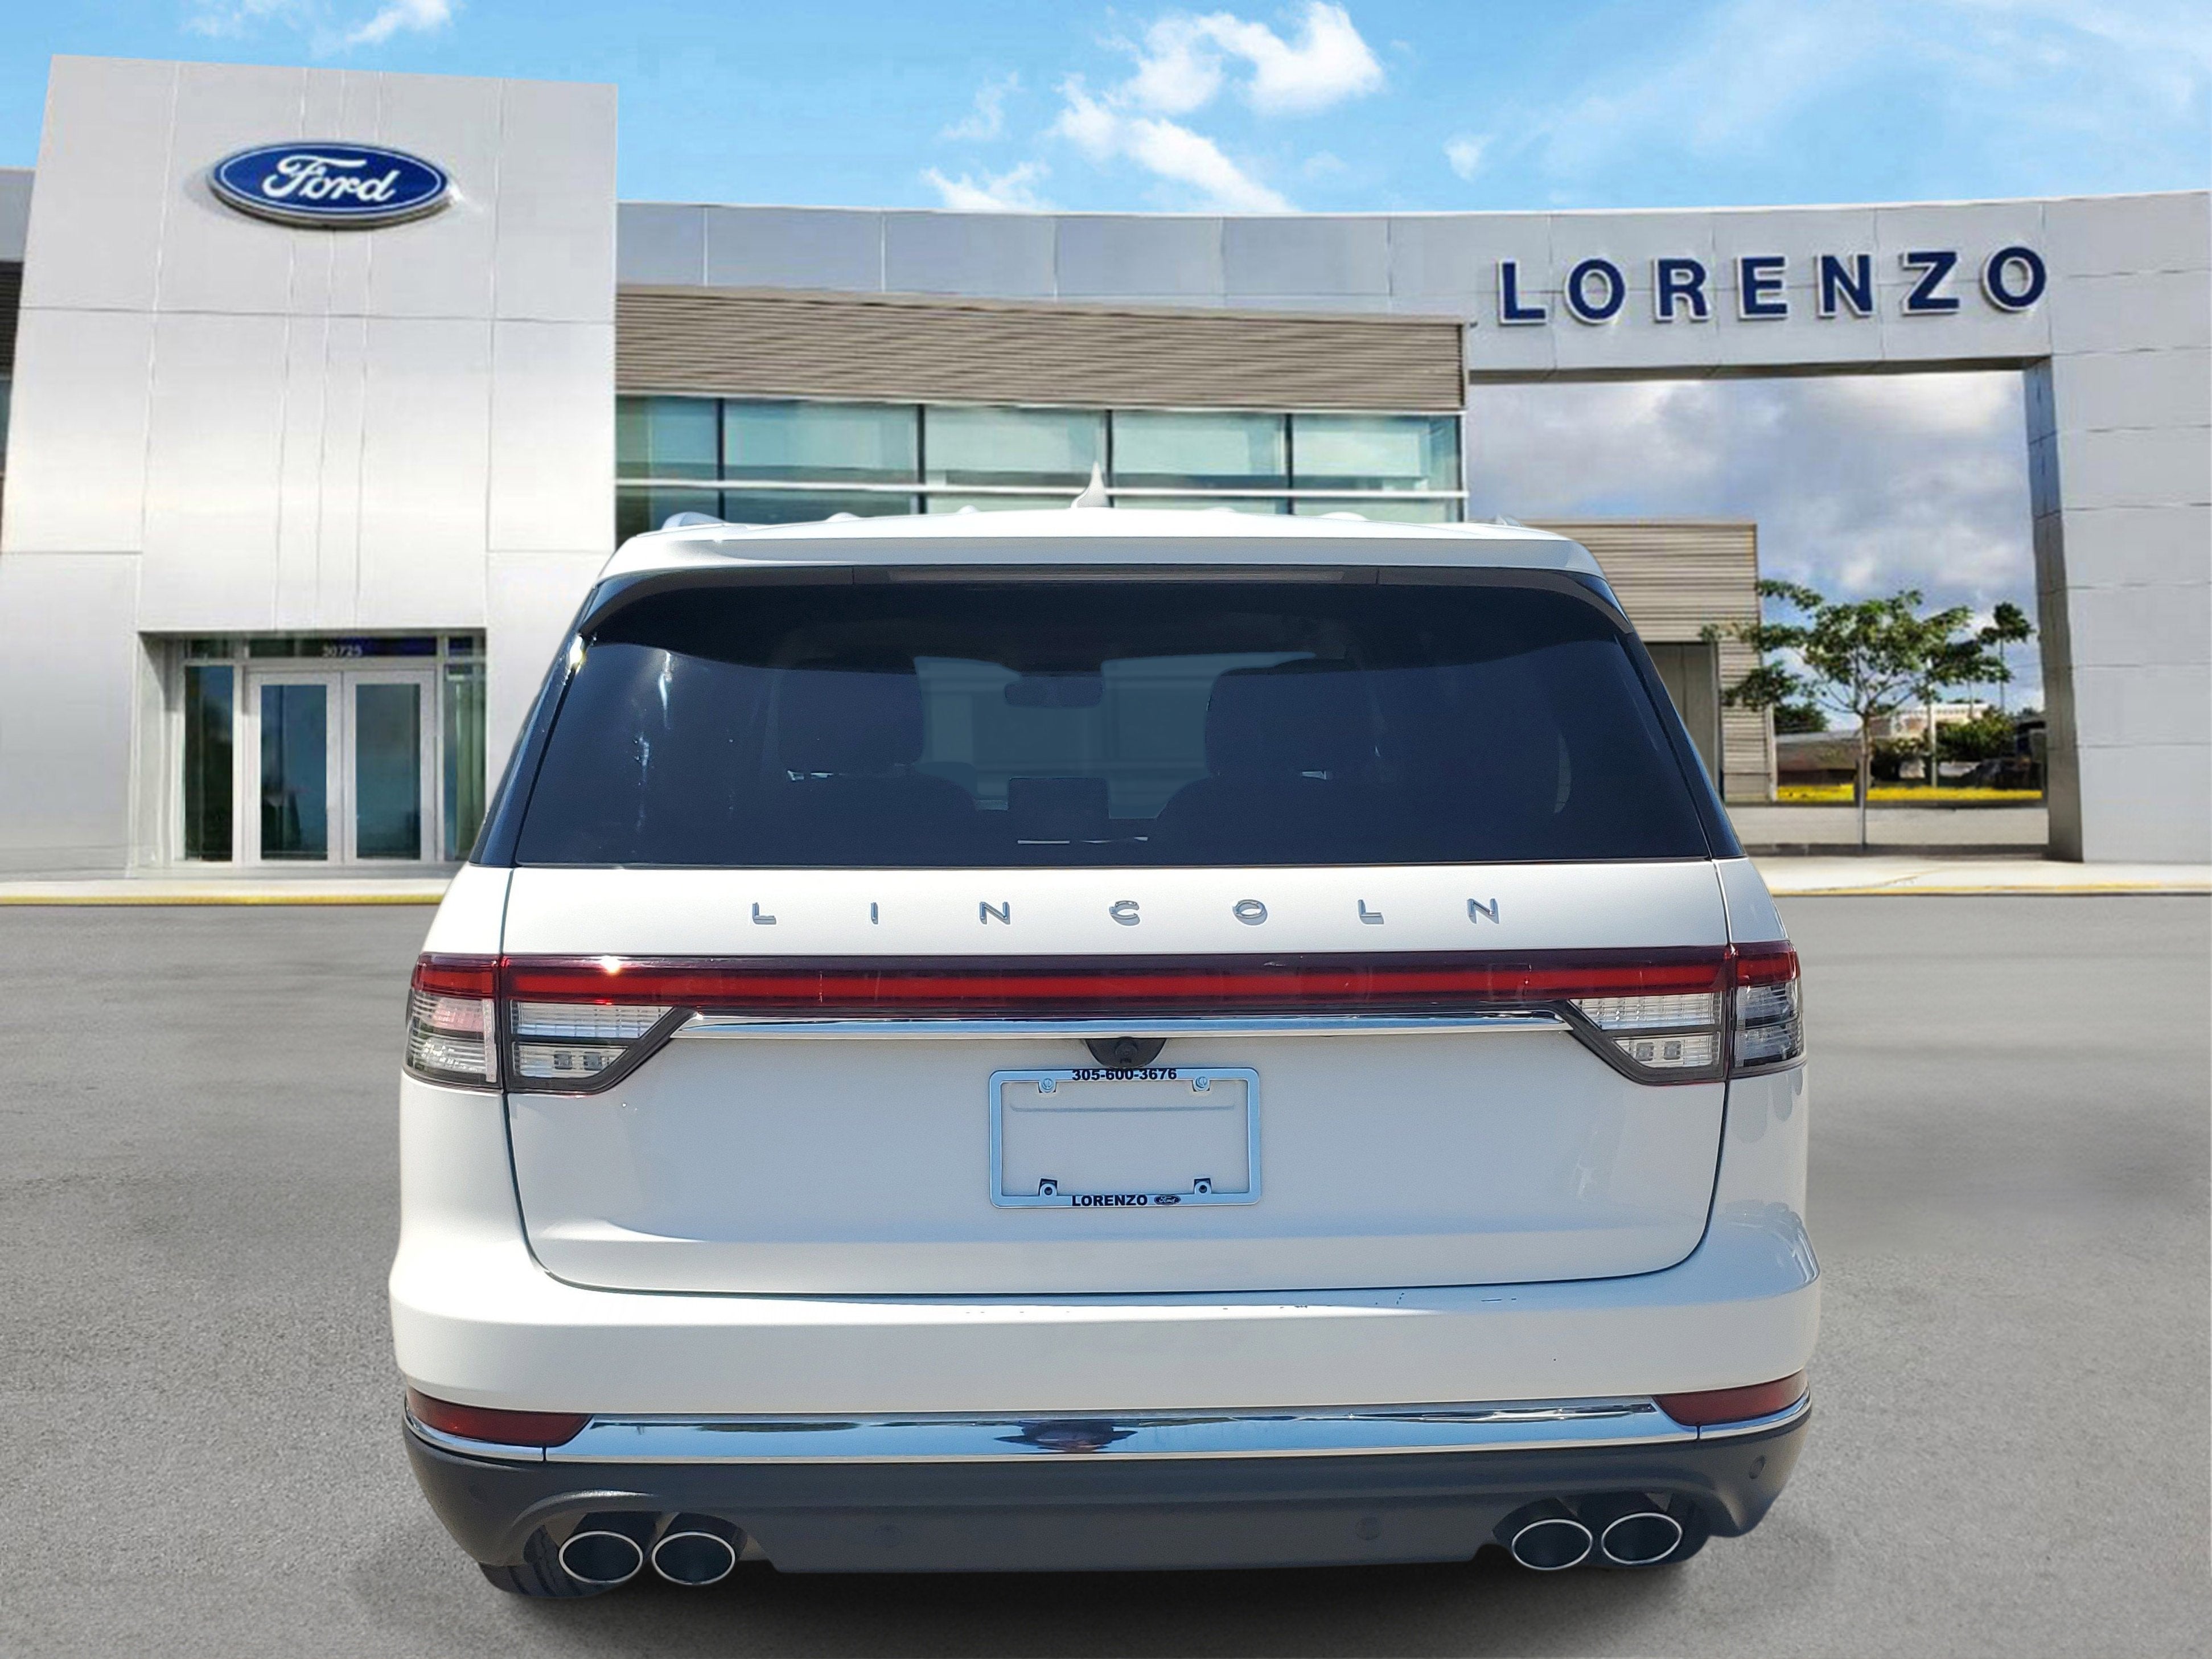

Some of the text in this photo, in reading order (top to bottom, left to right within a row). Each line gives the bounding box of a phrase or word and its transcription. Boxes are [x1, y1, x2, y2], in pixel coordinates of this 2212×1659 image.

[263, 155, 399, 202] Ford
[1499, 246, 2047, 322] LORENZO
[752, 898, 1499, 925] LINCOLN
[1072, 1069, 1177, 1081] 305-600-3676
[1072, 1194, 1148, 1206] LORENZO
